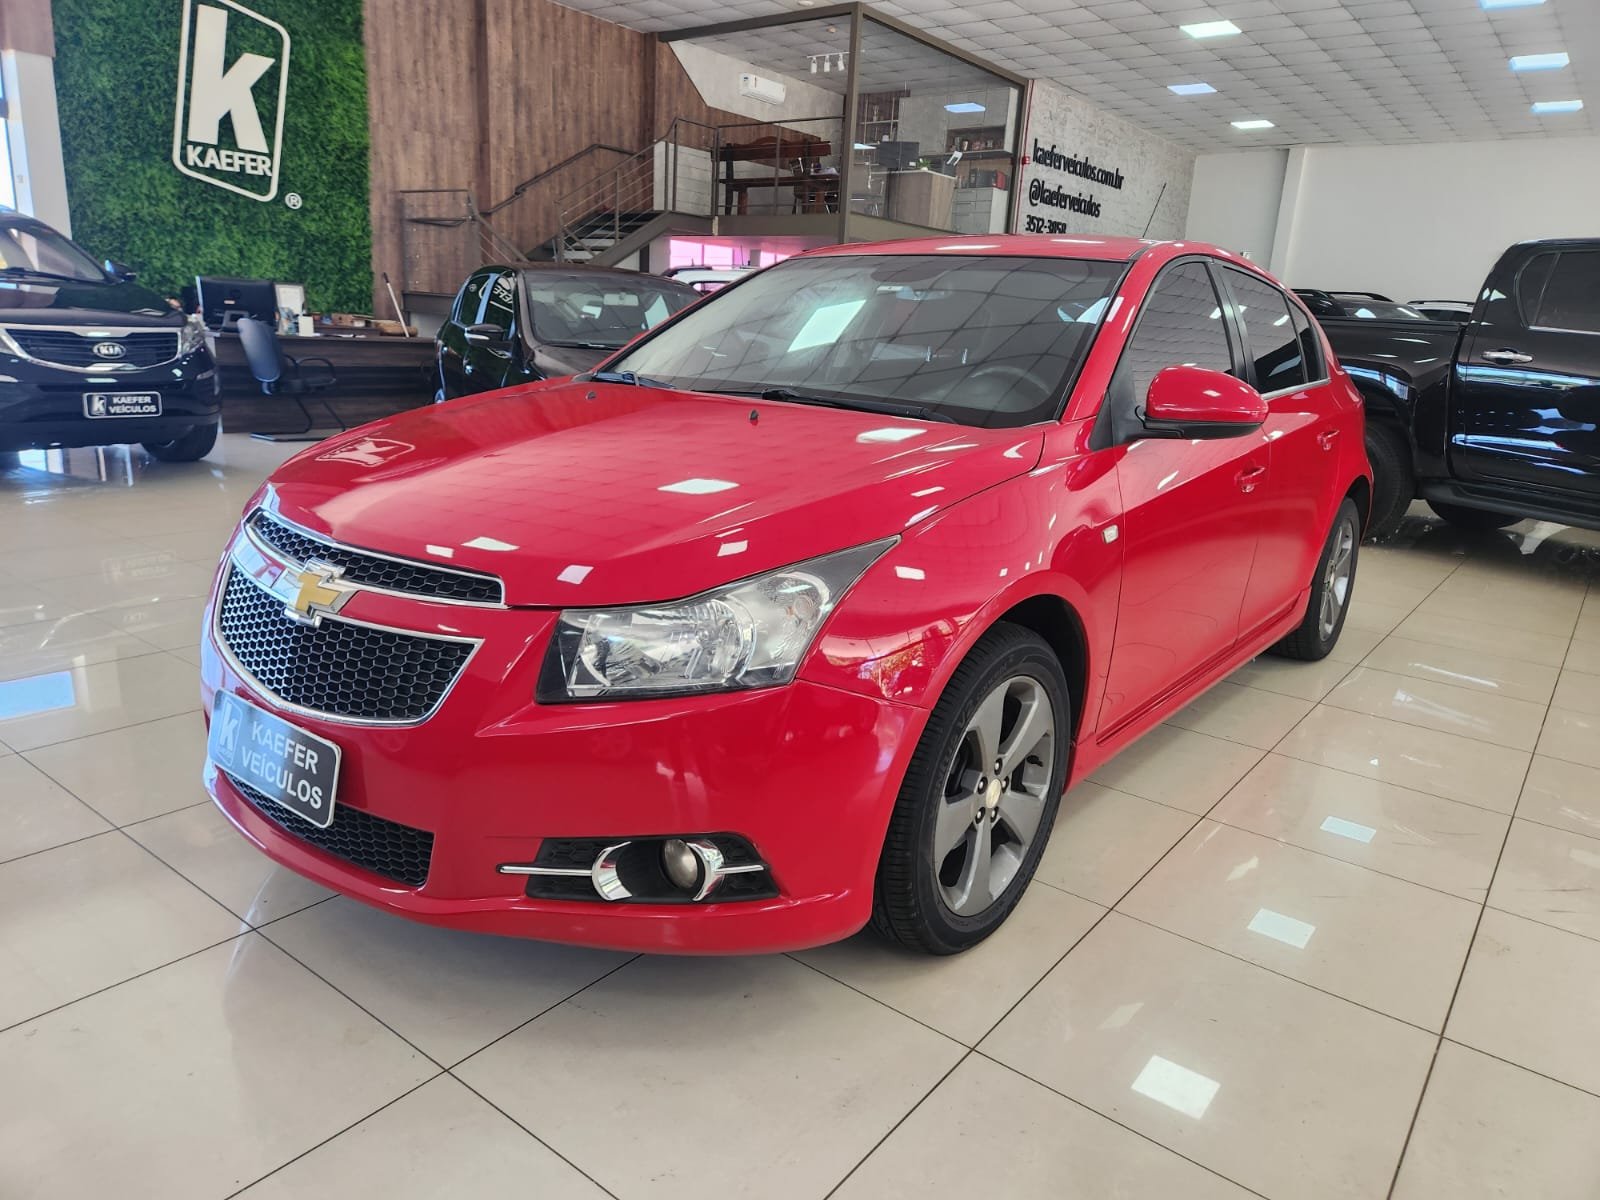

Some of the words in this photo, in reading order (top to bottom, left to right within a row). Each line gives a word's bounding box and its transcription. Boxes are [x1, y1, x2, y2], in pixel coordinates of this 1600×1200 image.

[187, 145, 272, 176] KAEFER
[1033, 138, 1124, 190] kaeferveiculos.com.br
[1029, 178, 1101, 218] @kaeferveiculos
[108, 404, 157, 413] VEÍCULOS
[112, 396, 152, 404] KAEFER
[251, 720, 319, 775] KAEFER
[241, 746, 323, 810] VEÍCULOS
